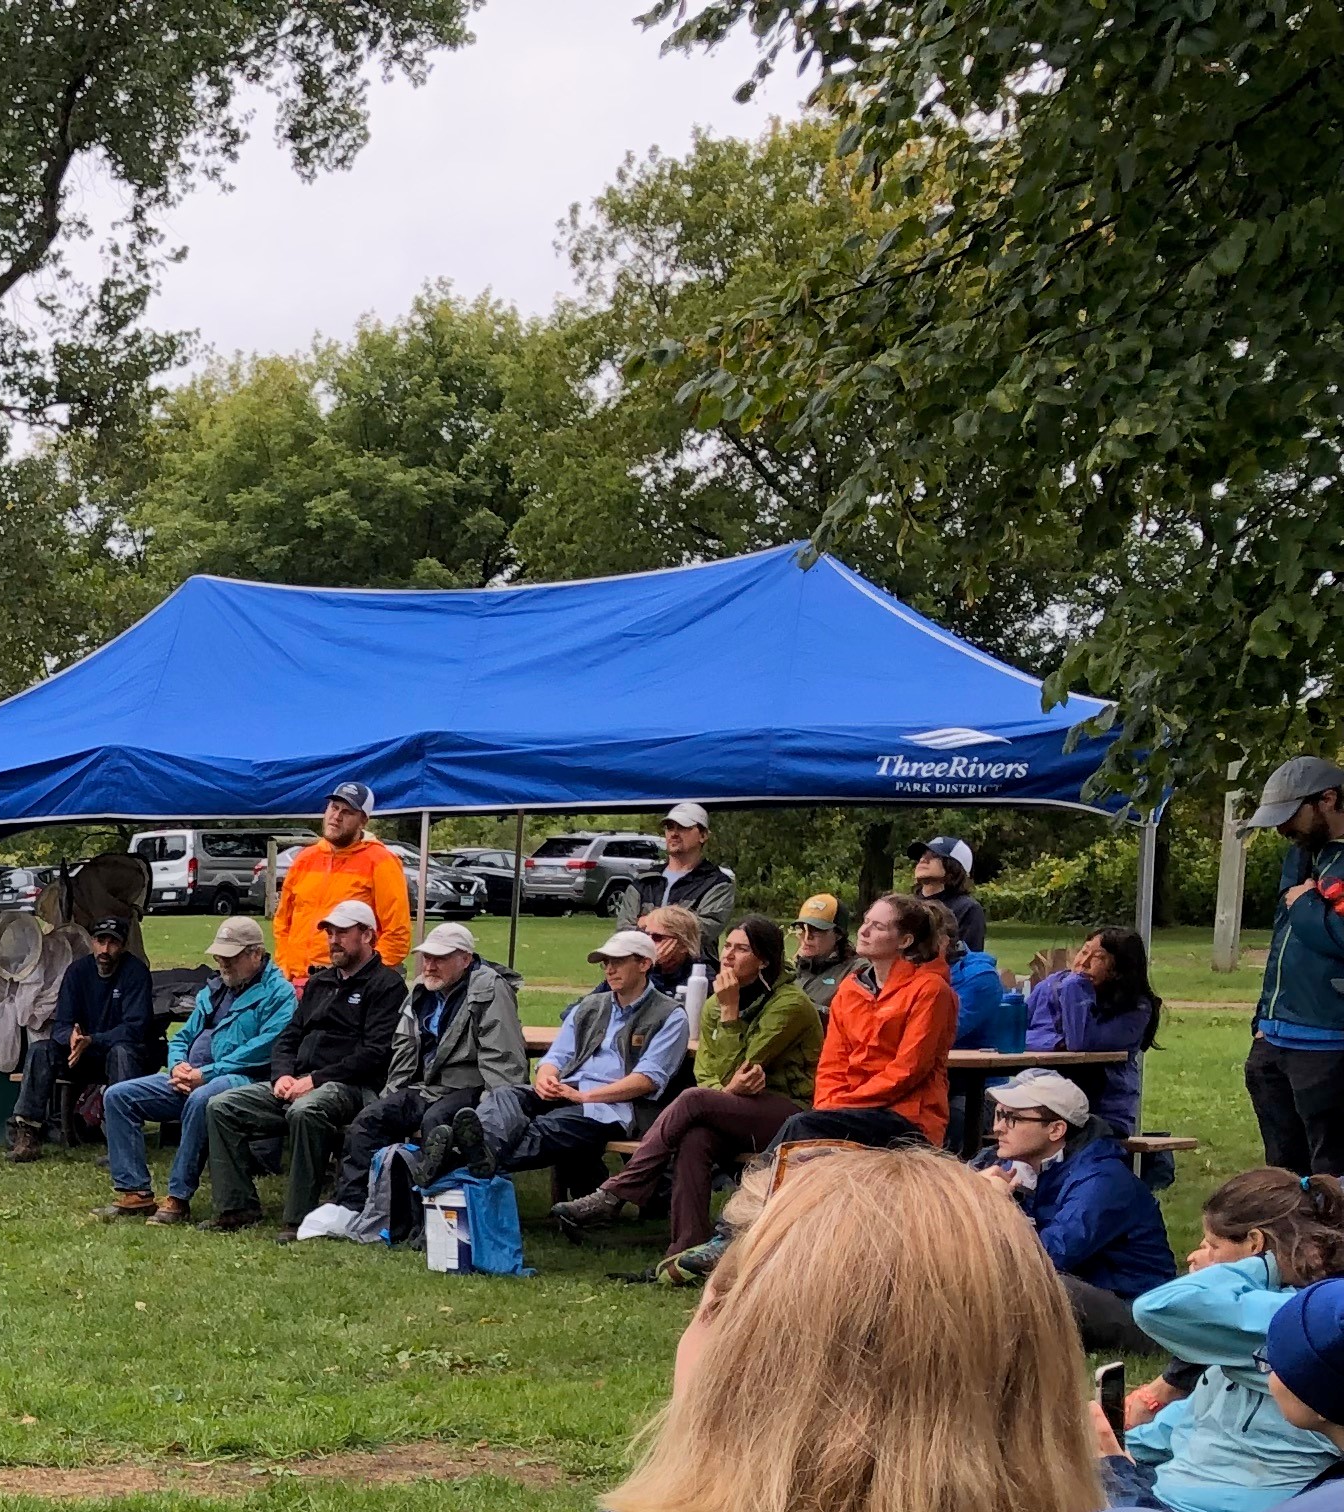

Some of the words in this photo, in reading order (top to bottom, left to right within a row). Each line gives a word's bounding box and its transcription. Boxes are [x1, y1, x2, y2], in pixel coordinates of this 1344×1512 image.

[875, 754, 1030, 779] ThreeRivers
[895, 781, 932, 793] PARK
[935, 782, 1003, 794] DISTRICT
